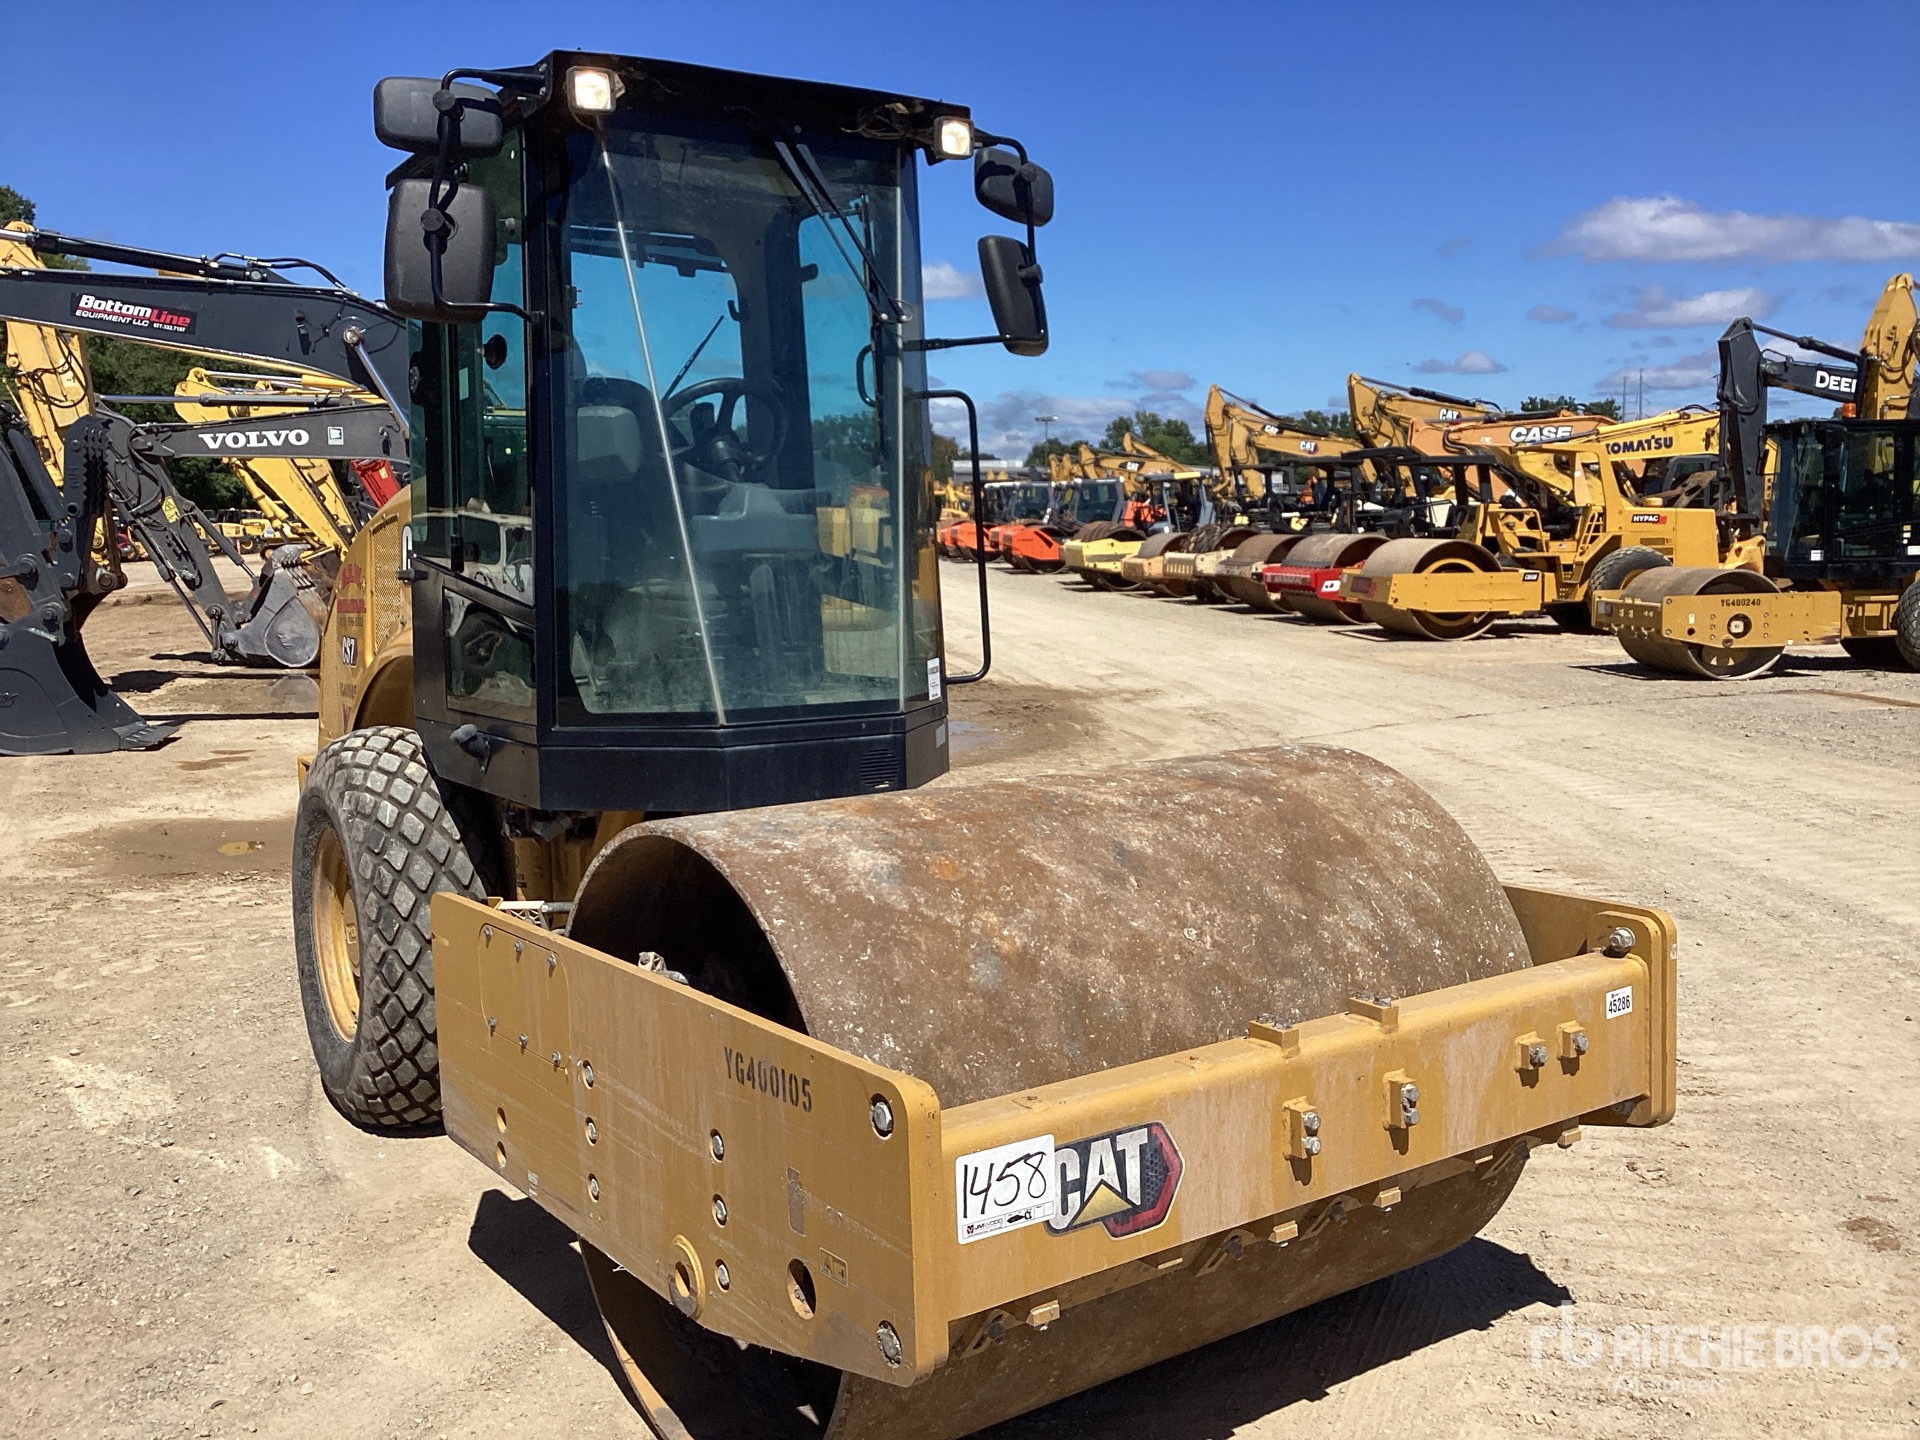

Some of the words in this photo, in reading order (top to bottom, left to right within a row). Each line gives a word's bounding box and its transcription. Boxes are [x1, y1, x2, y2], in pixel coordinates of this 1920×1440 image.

[76, 310, 132, 323] EQUIPMENT
[1439, 408, 1459, 420] CAT
[1264, 424, 1279, 435] CAT
[1511, 427, 1572, 446] CASE
[198, 429, 310, 449] VOLVO
[1300, 441, 1315, 454] CAT
[1126, 462, 1139, 471] CAT
[1721, 598, 1761, 607] YG400240
[1608, 995, 1630, 1013] 45286
[724, 1046, 812, 1113] YG400105
[963, 1151, 1048, 1219] 1458
[1053, 1127, 1149, 1231] CAT
